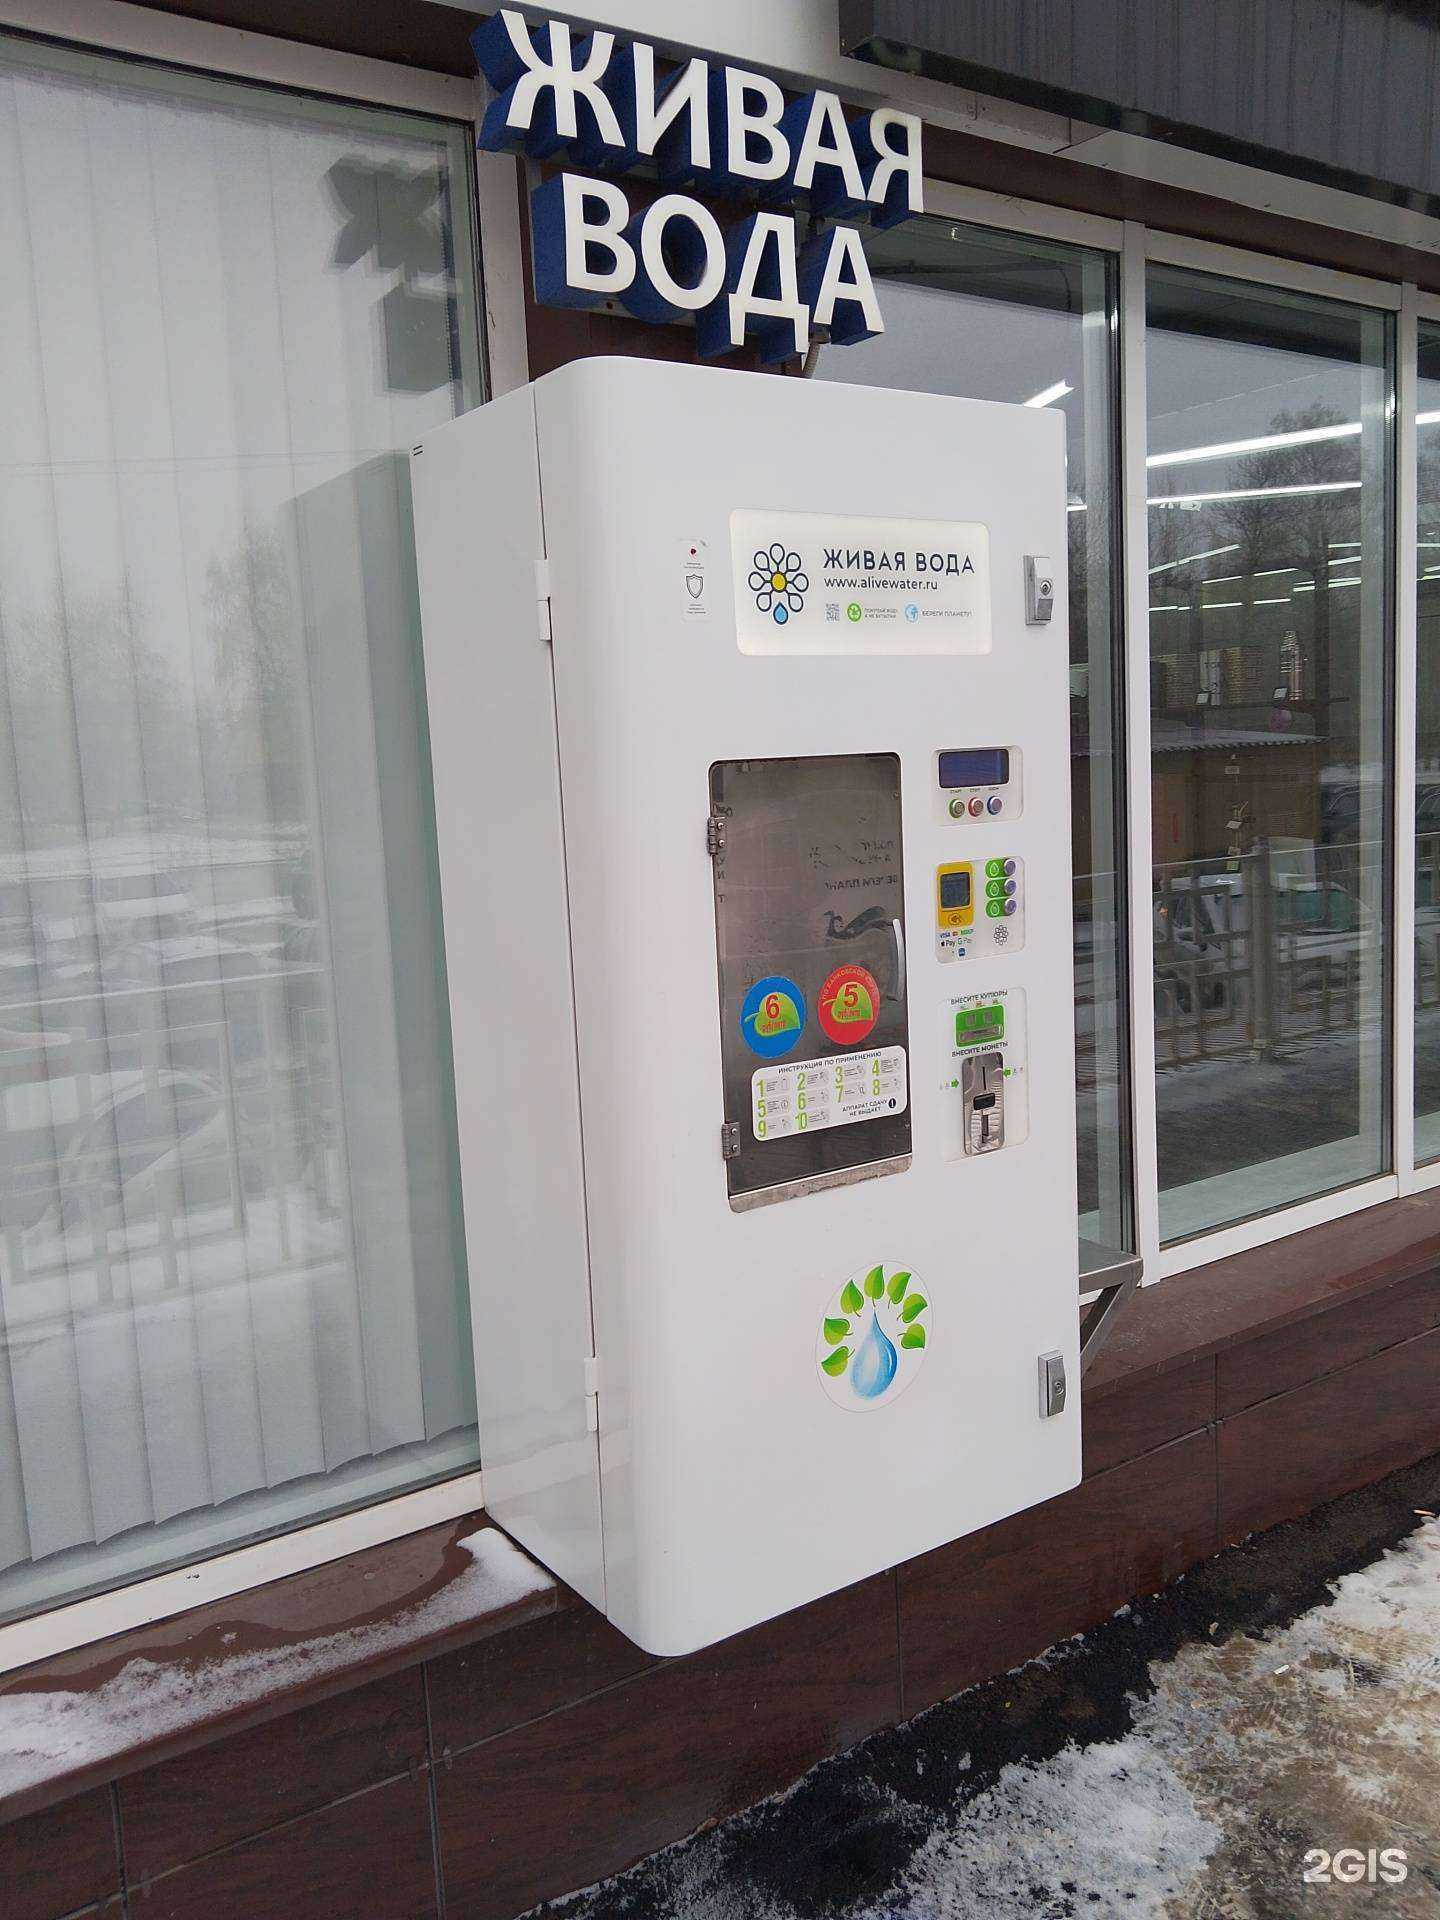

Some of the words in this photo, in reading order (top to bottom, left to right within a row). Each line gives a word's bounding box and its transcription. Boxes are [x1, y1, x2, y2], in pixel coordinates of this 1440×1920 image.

[500, 9, 924, 213] ЖИВАЯ
[562, 173, 885, 353] ВОДА
[823, 549, 906, 571] ЖИВАЯ
[916, 553, 975, 576] ВОДА
[824, 576, 938, 590] www.alivewater.ru
[844, 984, 859, 1008] 5
[951, 995, 979, 1005] ВНЕСИТЕ
[980, 990, 1008, 1000] КУПЮРЫ
[765, 994, 780, 1019] 6
[952, 1047, 980, 1057] ВНЕСИТЕ
[981, 1041, 1008, 1051] МОНЕТЫ
[778, 1061, 823, 1074] ИНСТРУКЦИЯ
[824, 1058, 834, 1066] ПО
[835, 1051, 882, 1064] ПРИМЕНЕНИЮ
[872, 1059, 880, 1076] 4
[797, 1073, 806, 1091] 2
[835, 1066, 843, 1084] 3
[757, 1079, 765, 1097] 1
[835, 1085, 844, 1103] 7
[872, 1079, 880, 1096] 8
[758, 1100, 766, 1118] 5
[797, 1092, 806, 1110] 6
[758, 1120, 767, 1138] 9
[795, 1112, 808, 1130] 10
